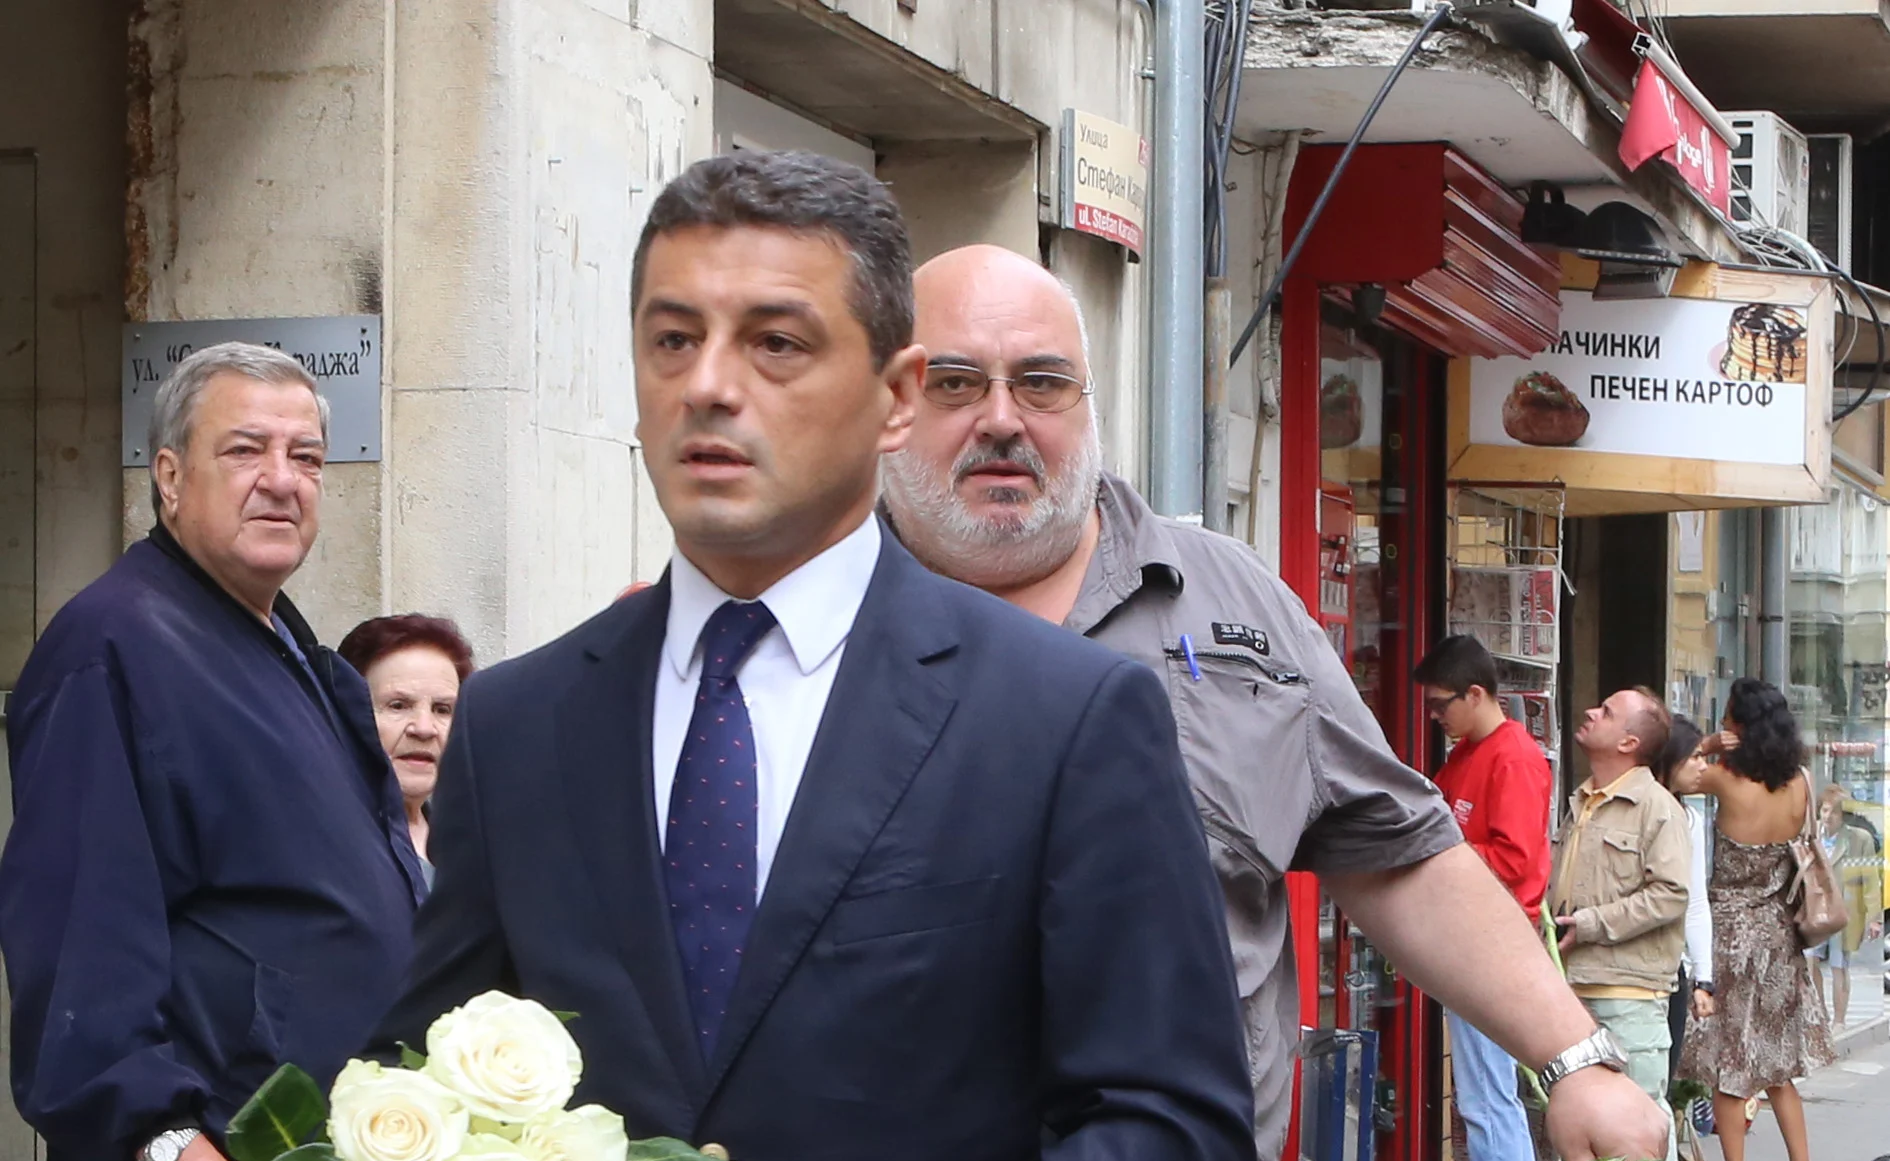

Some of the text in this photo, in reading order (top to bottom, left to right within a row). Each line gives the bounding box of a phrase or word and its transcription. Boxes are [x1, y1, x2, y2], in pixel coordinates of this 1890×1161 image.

[1077, 157, 1126, 200] Стефан
[132, 354, 160, 393] ул.
[1590, 374, 1774, 408] ПЕЧЕН КАРТОФ
